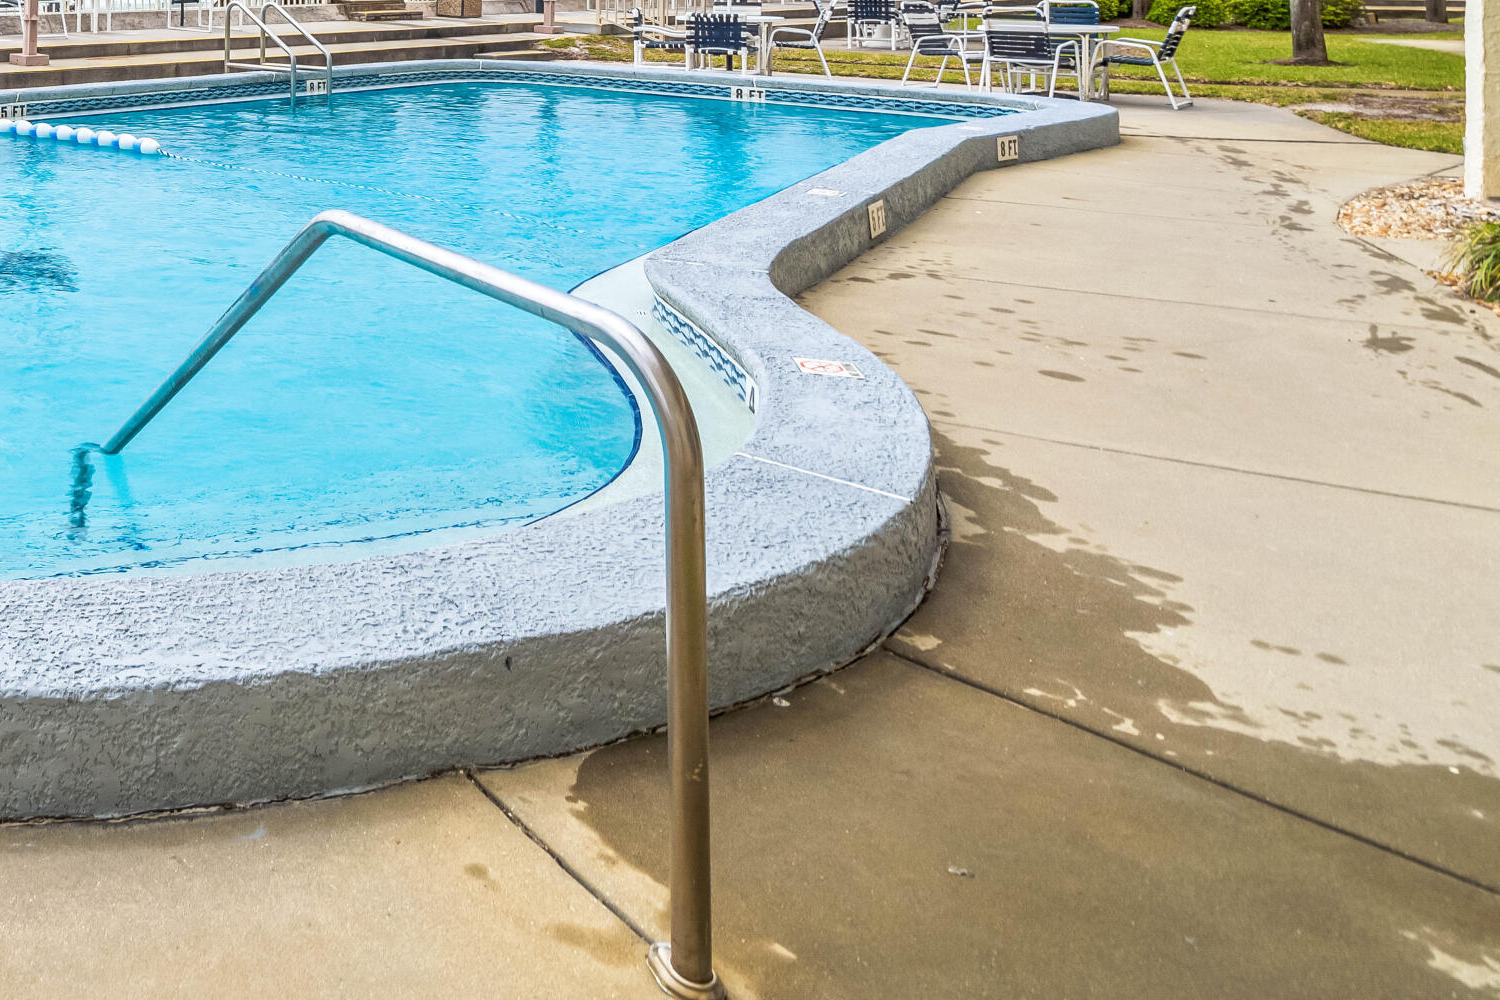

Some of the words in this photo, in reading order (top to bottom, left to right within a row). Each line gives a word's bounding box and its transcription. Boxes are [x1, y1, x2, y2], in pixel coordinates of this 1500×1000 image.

[317, 81, 327, 92] FT
[748, 89, 764, 99] FT
[0, 106, 8, 118] 5
[12, 104, 26, 118] FT
[1000, 140, 1006, 157] 8
